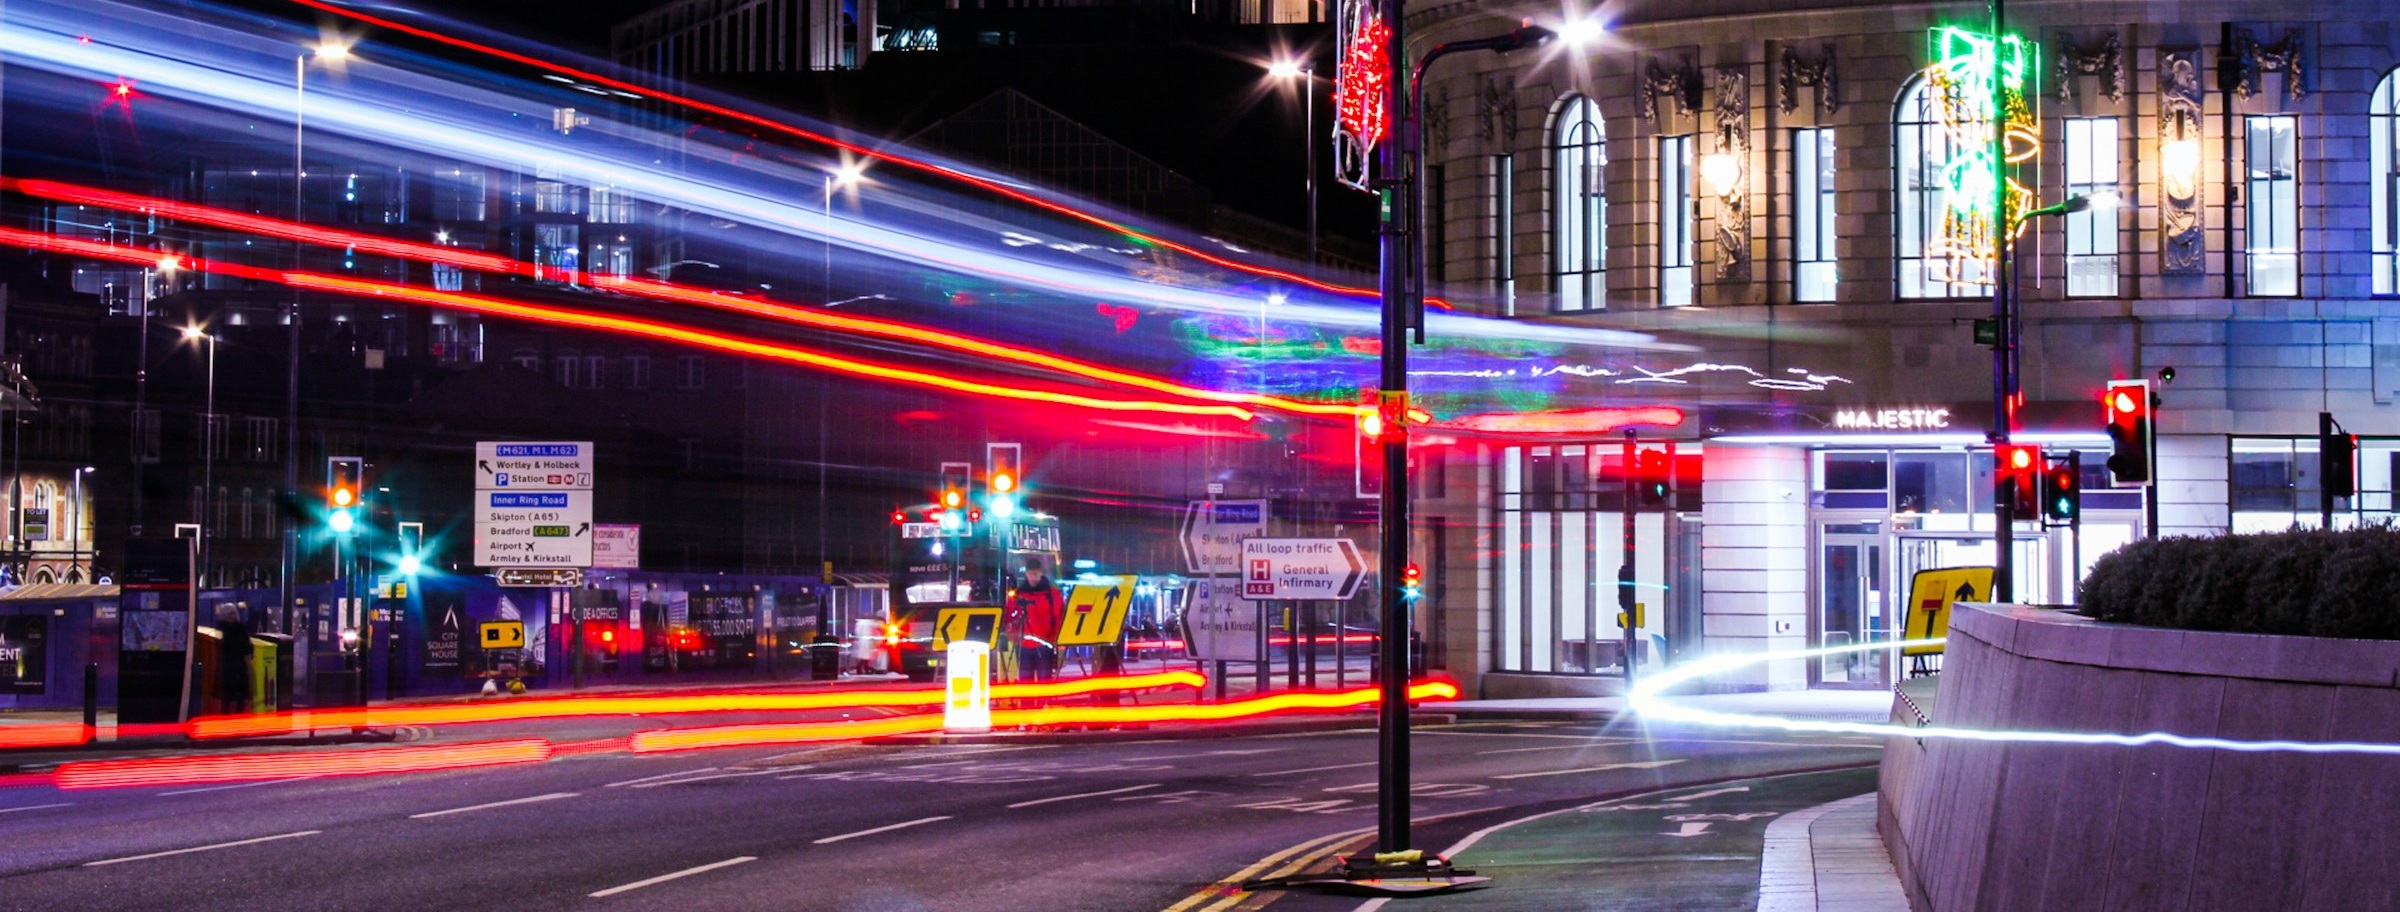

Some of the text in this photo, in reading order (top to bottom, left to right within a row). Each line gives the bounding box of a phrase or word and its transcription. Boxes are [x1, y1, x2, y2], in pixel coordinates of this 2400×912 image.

[1835, 409, 1950, 429] MAJESTIC
[496, 461, 532, 470] Wortley
[543, 460, 580, 468] Holbeck
[511, 475, 544, 483] Station
[493, 495, 565, 506] Inner Ring Road
[490, 512, 560, 522] Skipton (A65)
[490, 527, 569, 536] Bradford (A647)
[490, 542, 522, 551] Airport
[1247, 543, 1333, 554] All loop traffic
[490, 555, 522, 563] Armley
[533, 554, 572, 562] Kirkstall
[1253, 561, 1268, 579] H
[1283, 564, 1329, 575] General
[1279, 577, 1333, 589] Infirmary
[1214, 584, 1233, 594] tation
[596, 607, 618, 619] OFFICES
[441, 632, 459, 641] CITY
[427, 641, 458, 650] SQUARE
[431, 650, 458, 659] HOUSE
